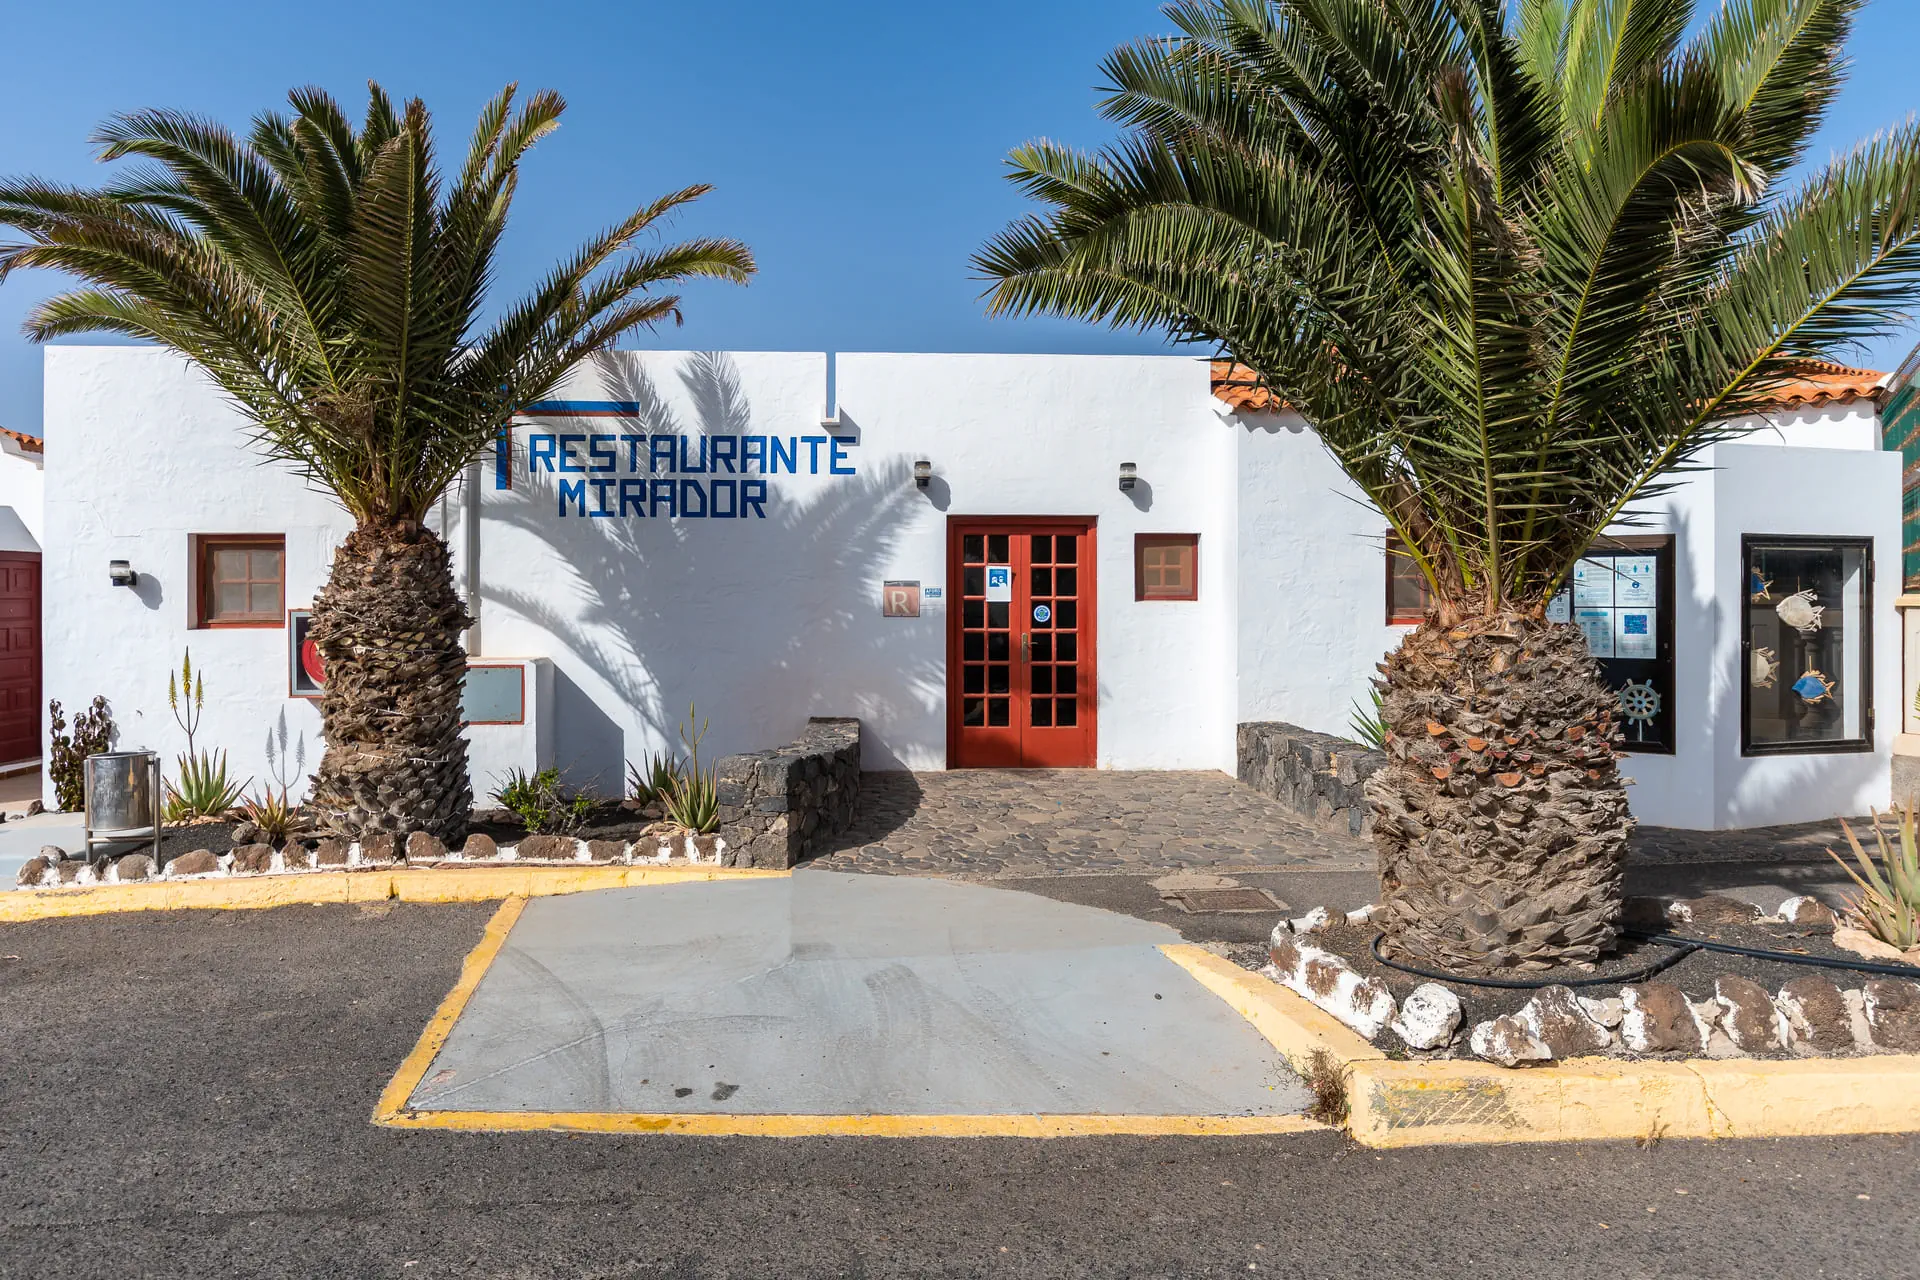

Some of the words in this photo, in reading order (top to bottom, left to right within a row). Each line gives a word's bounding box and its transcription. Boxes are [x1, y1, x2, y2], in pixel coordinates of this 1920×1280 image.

[529, 434, 856, 475] RESTAURANTE
[559, 479, 767, 518] MIRADOR
[891, 590, 910, 614] R
